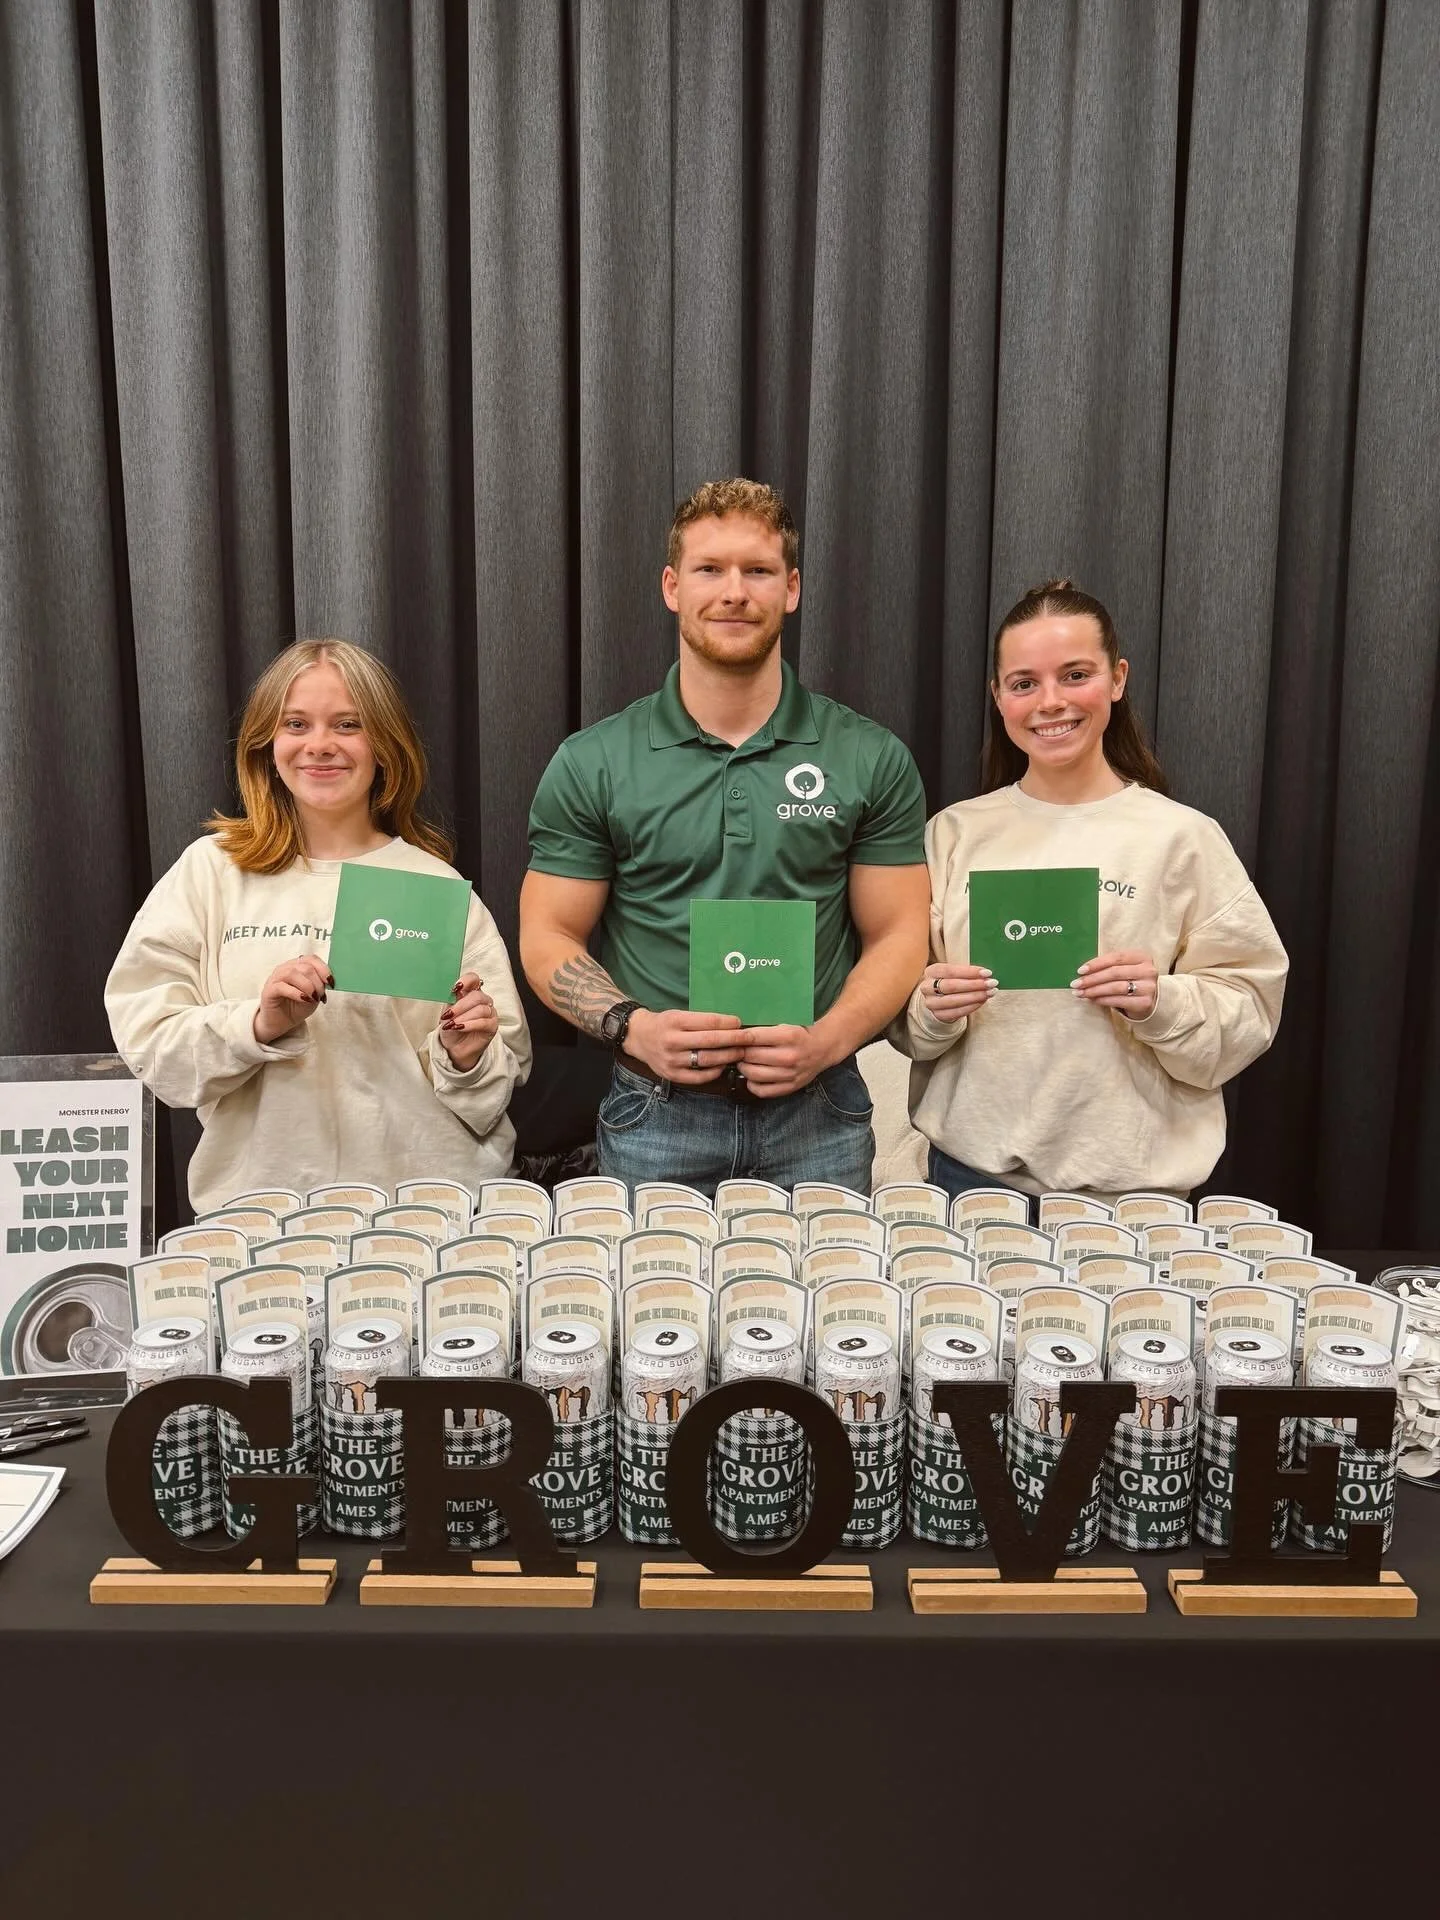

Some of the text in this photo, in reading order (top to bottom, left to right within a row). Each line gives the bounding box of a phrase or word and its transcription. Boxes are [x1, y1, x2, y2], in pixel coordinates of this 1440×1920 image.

[776, 802, 836, 819] grove
[223, 926, 260, 944] MEET
[263, 926, 287, 937] ME
[291, 924, 312, 936] AT
[395, 927, 429, 940] grove
[1029, 924, 1063, 936] grove
[748, 955, 781, 967] grove
[0, 1126, 129, 1155] LEASH
[13, 1159, 129, 1187] YOUR
[23, 1190, 129, 1219] NEXT
[6, 1223, 128, 1253] HOME
[356, 1348, 392, 1361] SUGAR
[561, 1353, 595, 1366] SUGAR
[669, 1352, 699, 1368] SUGAR
[737, 1351, 762, 1363] ZERO
[456, 1359, 492, 1372] SUGAR
[857, 1358, 889, 1370] SUGAR
[954, 1360, 988, 1371] SUGAR
[1033, 1363, 1096, 1379] ZERO SUGAR
[1132, 1363, 1161, 1375] ZERO
[1235, 1360, 1266, 1372] ZERO
[1327, 1361, 1356, 1376] ZERO
[334, 1436, 377, 1455] THE
[746, 1444, 789, 1463] THE
[235, 1448, 281, 1465] THE
[322, 1448, 405, 1480] GROVE
[546, 1451, 575, 1468] HE
[637, 1448, 669, 1467] TH
[852, 1450, 879, 1467] HE
[931, 1448, 966, 1470] TH
[1149, 1451, 1190, 1471] THE
[620, 1460, 666, 1492] GRO
[721, 1452, 805, 1488] GROVE
[854, 1462, 898, 1493] OVE
[910, 1458, 966, 1494] GRO
[107, 1375, 1396, 1587] GROVE
[1119, 1466, 1194, 1496] GROV
[1337, 1478, 1395, 1505] OVE
[336, 1502, 377, 1518] AMES
[745, 1509, 787, 1526] AMES
[639, 1515, 673, 1529] AME
[928, 1514, 971, 1531] AMES
[1147, 1516, 1186, 1533] AMES
